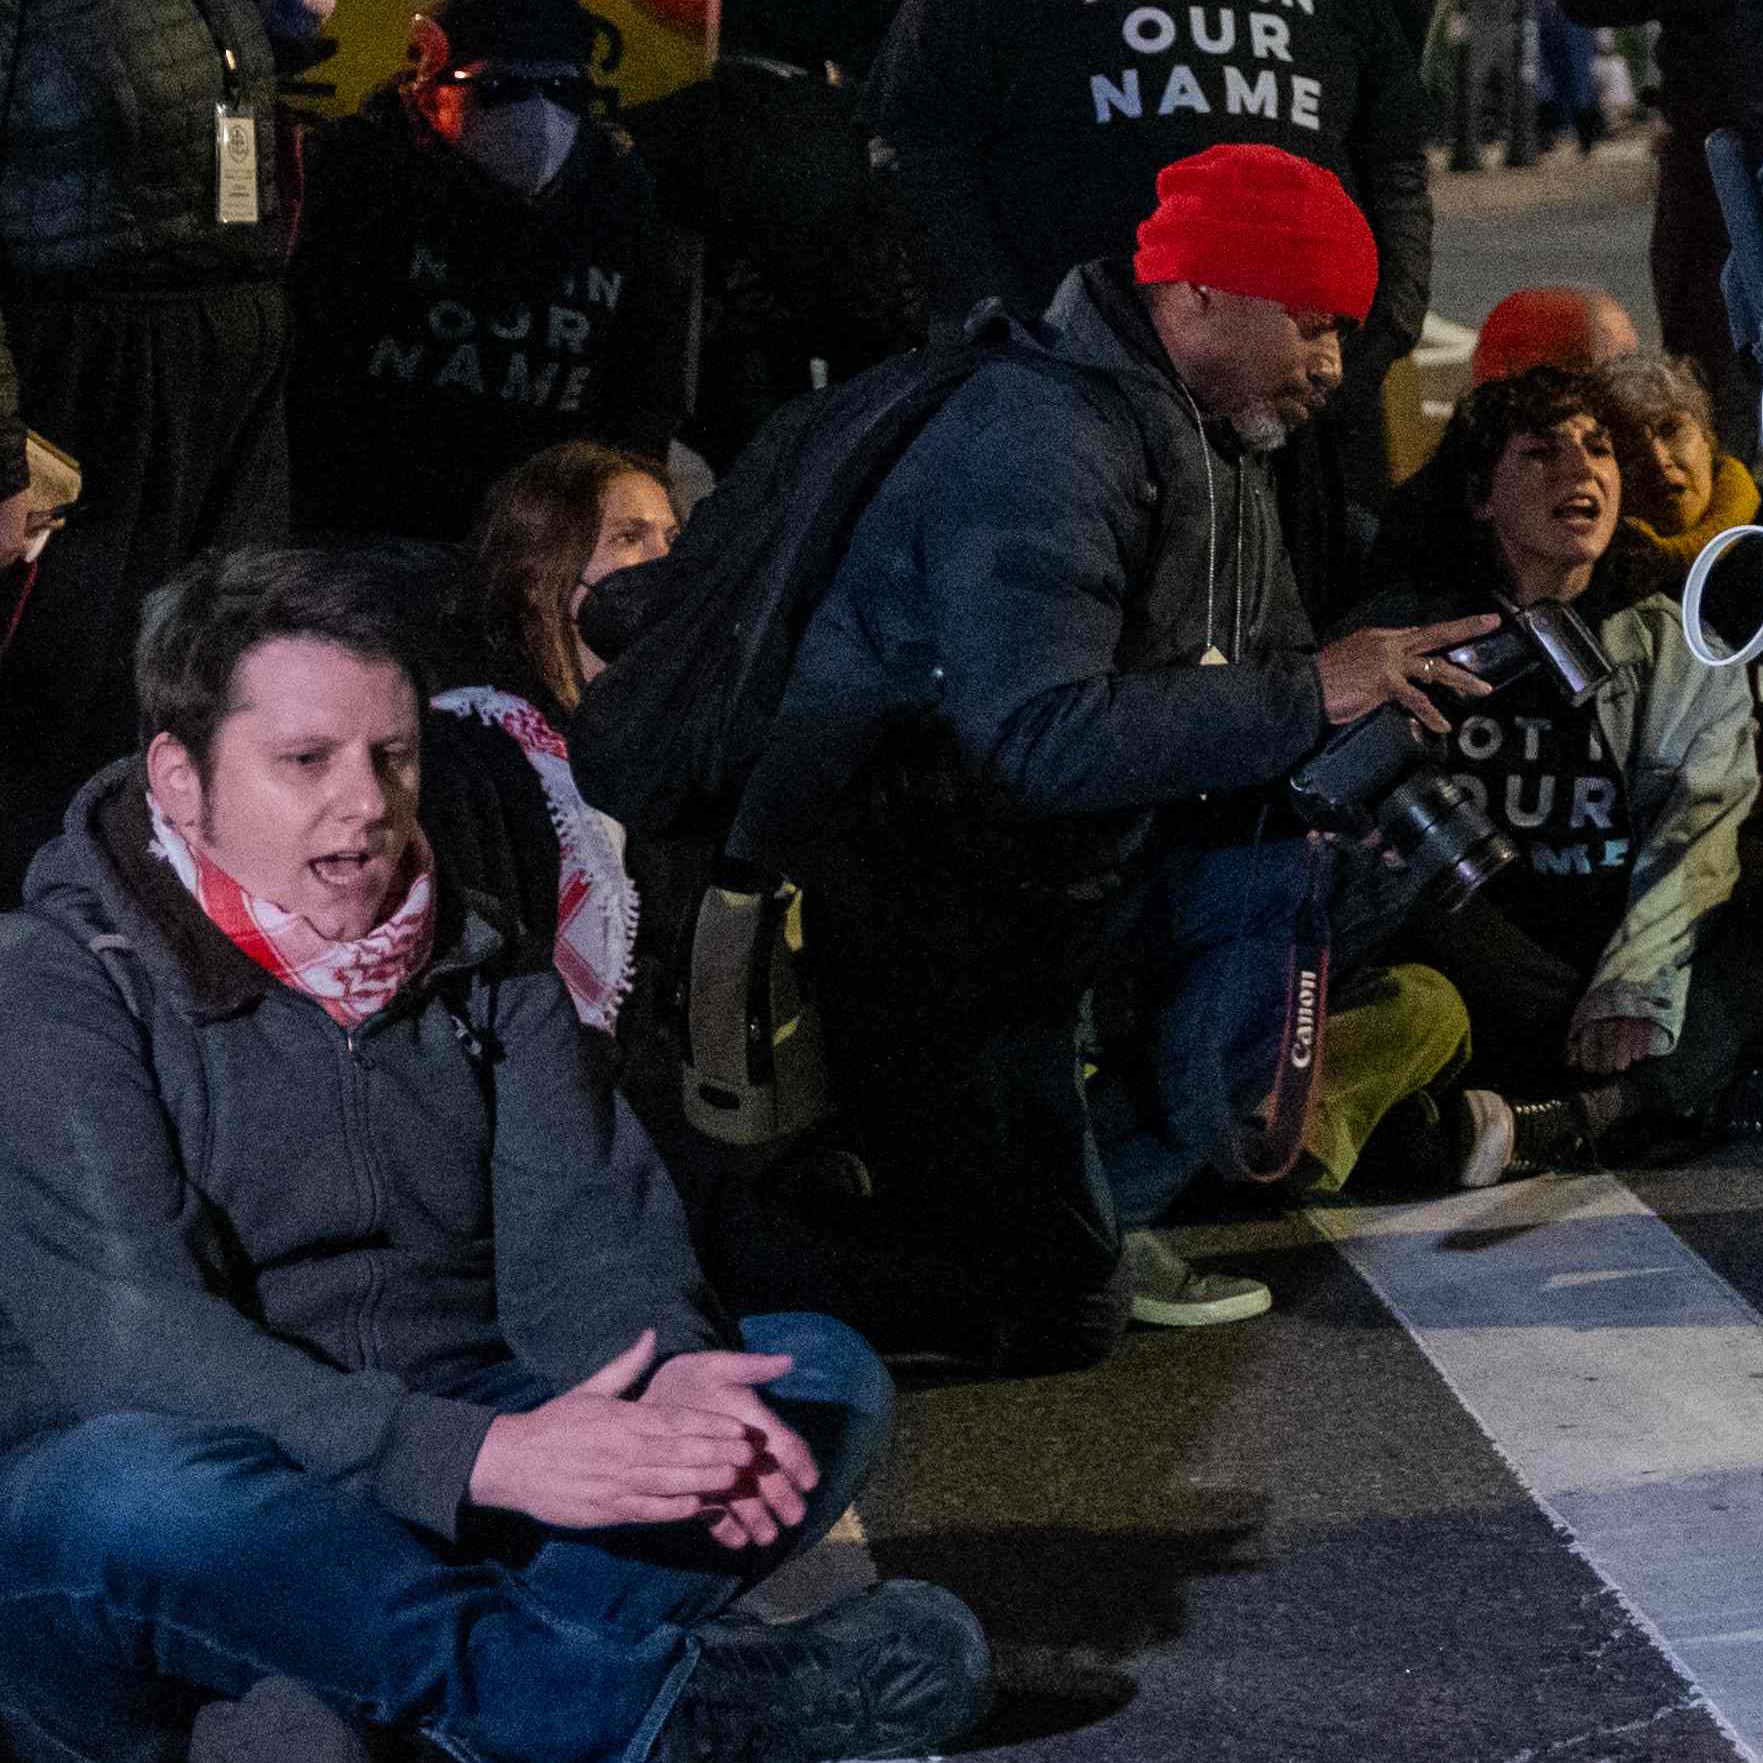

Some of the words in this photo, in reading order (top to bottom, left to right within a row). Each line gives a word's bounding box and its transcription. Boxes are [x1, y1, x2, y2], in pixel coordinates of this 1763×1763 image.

[1122, 6, 1294, 62] OUR
[1090, 64, 1323, 131] NAME
[1440, 715, 1552, 761] OT
[1529, 840, 1631, 877] ME
[1291, 969, 1318, 1069] Canon
